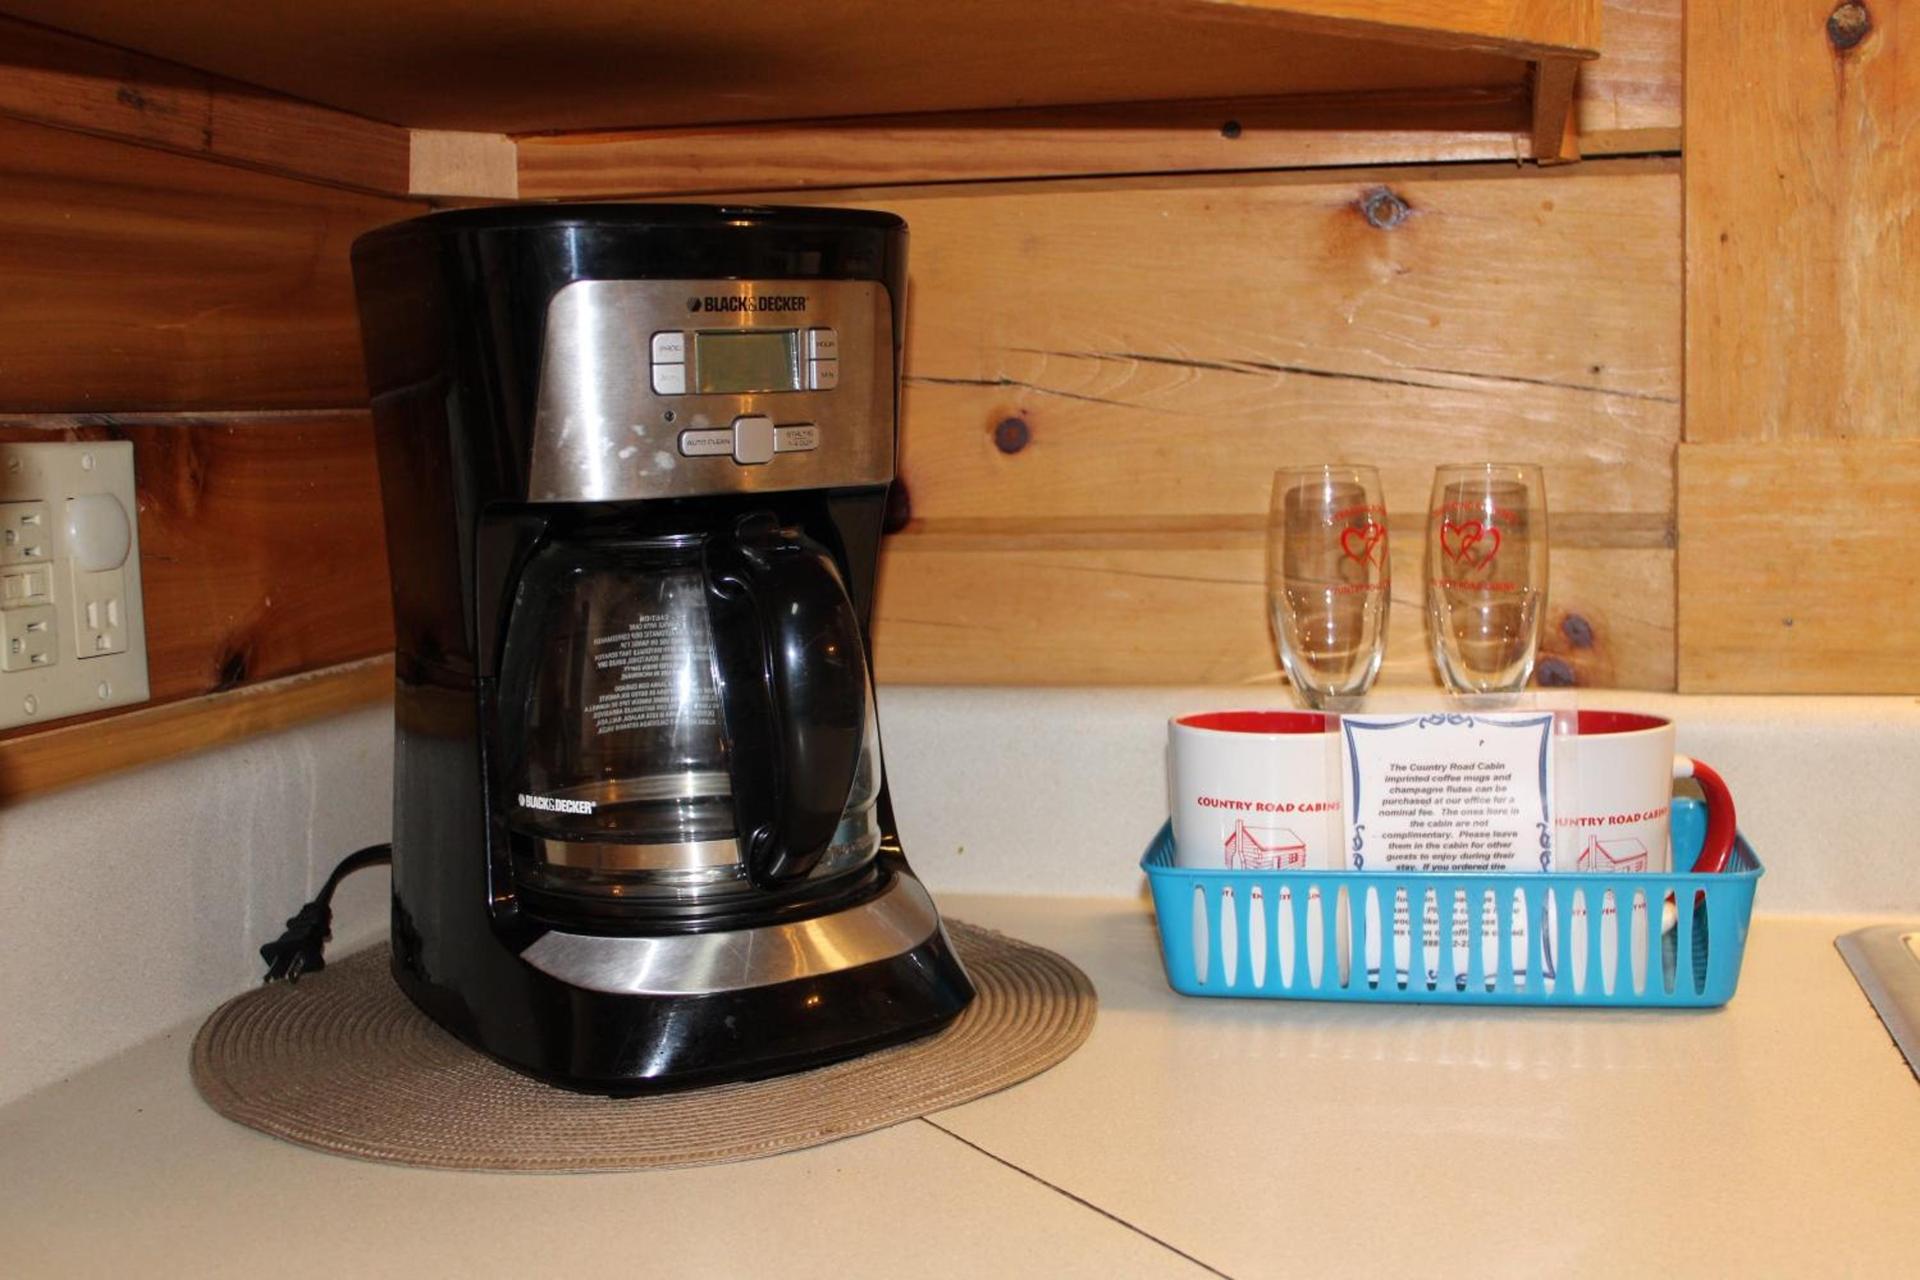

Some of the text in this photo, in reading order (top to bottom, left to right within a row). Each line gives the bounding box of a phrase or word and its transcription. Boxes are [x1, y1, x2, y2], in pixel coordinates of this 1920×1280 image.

[704, 296, 806, 312] BLACK&DECKER
[1390, 762, 1505, 773] The Country Road Cabin
[1385, 775, 1430, 784] imprinted
[1464, 775, 1490, 783] mugs
[1493, 773, 1512, 781] and
[1389, 786, 1444, 795] champagne
[525, 794, 593, 815] BLACK&DECKER
[1197, 796, 1253, 811] COUNTRY
[1256, 802, 1295, 813] ROAD
[1382, 797, 1432, 806] purchased
[1442, 808, 1459, 816] The
[1410, 820, 1425, 828] the
[1427, 820, 1453, 828] cabin
[1473, 819, 1489, 827] not
[1608, 813, 1642, 825] ROAD
[1459, 830, 1490, 838] Please
[1493, 830, 1518, 838] leave
[1389, 841, 1512, 850] them in the cabin for other
[1386, 854, 1418, 862] guests
[1432, 853, 1458, 862] enjoy
[1460, 852, 1491, 861] during
[1493, 852, 1516, 860] their
[1423, 863, 1431, 871] If
[1432, 864, 1450, 872] you
[1452, 863, 1489, 871] ordered
[1491, 863, 1507, 871] the
